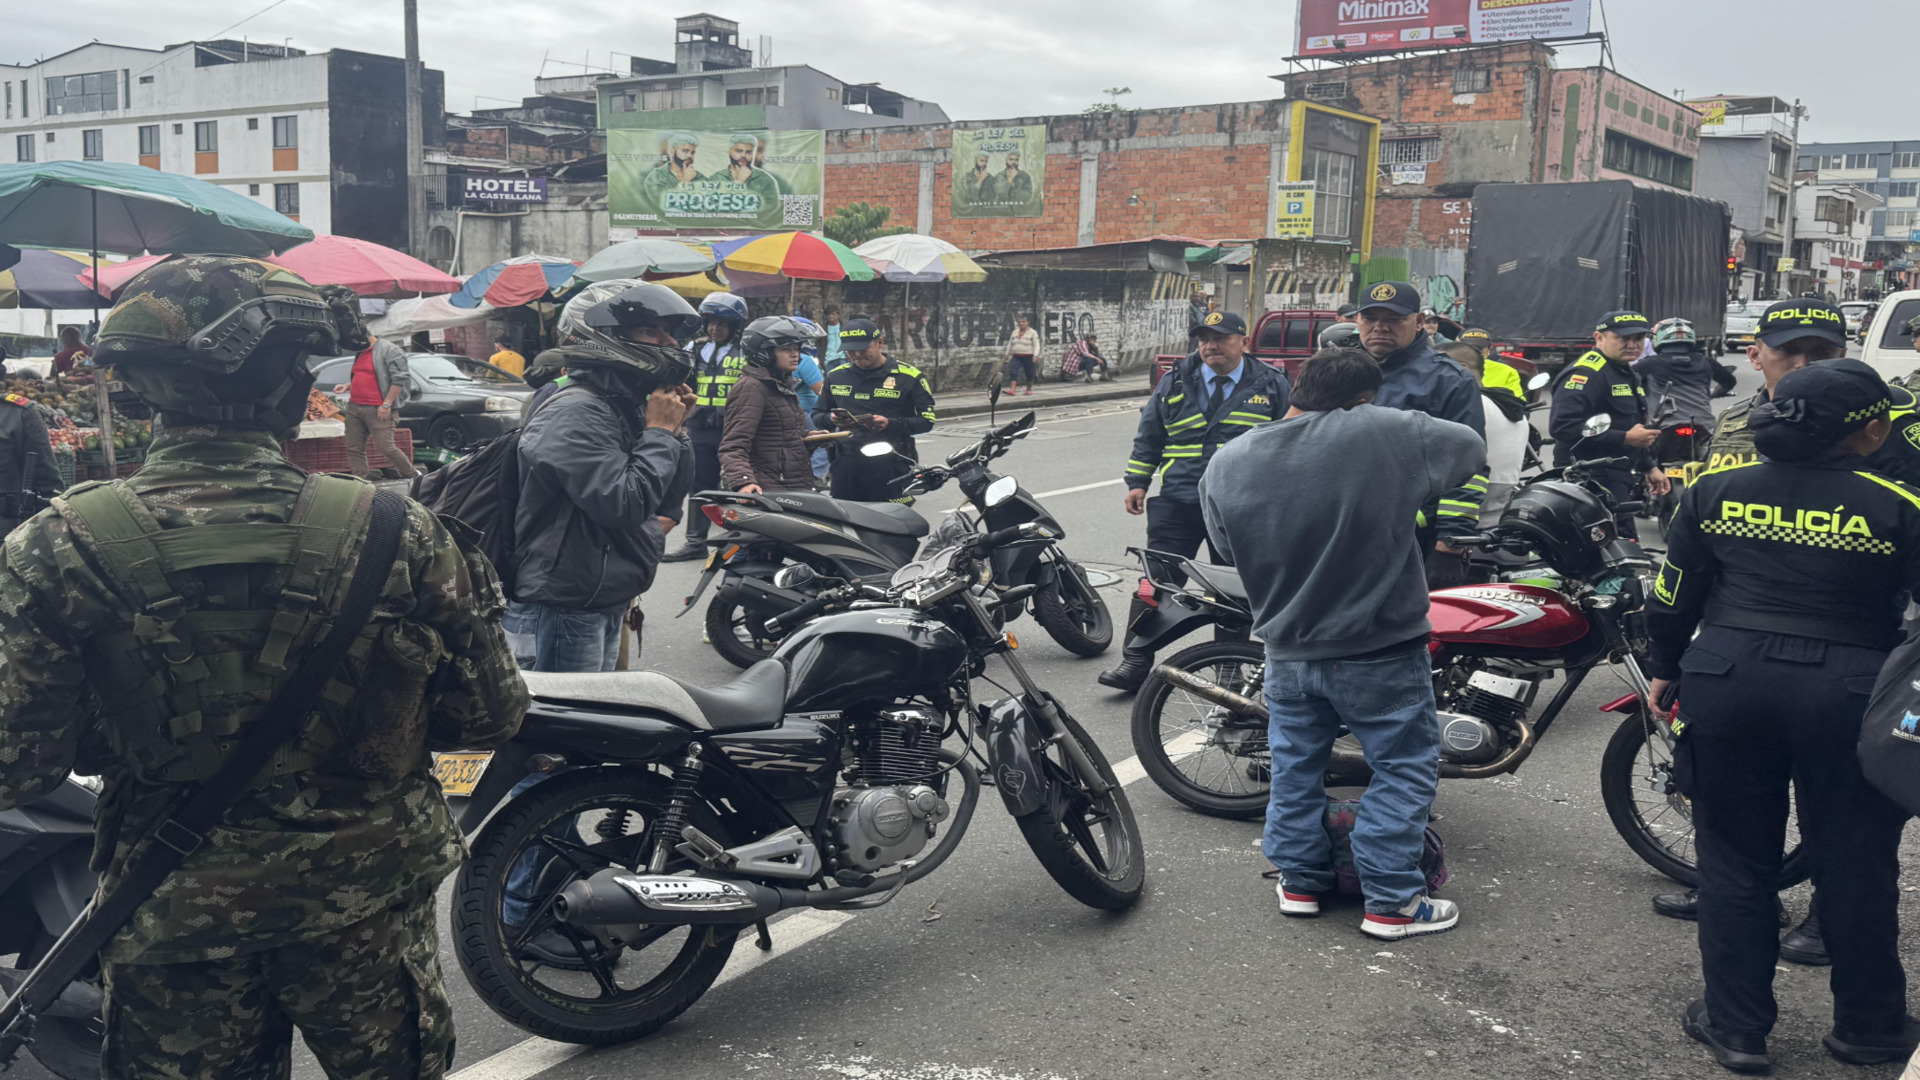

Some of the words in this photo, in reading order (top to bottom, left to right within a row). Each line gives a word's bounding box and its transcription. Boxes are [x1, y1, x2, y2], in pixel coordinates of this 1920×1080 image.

[1338, 0, 1429, 21] Minimax
[1487, 9, 1526, 18] Utensilios
[1540, 6, 1570, 14] Cocina
[1487, 14, 1563, 25] Electrodomésticos
[1487, 23, 1534, 32] Recipientes
[1535, 20, 1573, 29] Plásticos
[1514, 29, 1550, 37] Sartenes
[467, 178, 541, 193] HOTEL
[701, 182, 720, 190] LEY
[666, 192, 761, 211] PROCESO
[1442, 202, 1461, 214] SE
[1768, 308, 1841, 323] POLICÍA
[1709, 453, 1758, 471] POLI
[776, 497, 803, 507] auteco
[1722, 501, 1873, 538] POLICÍA
[1468, 590, 1547, 606] SUZUKI
